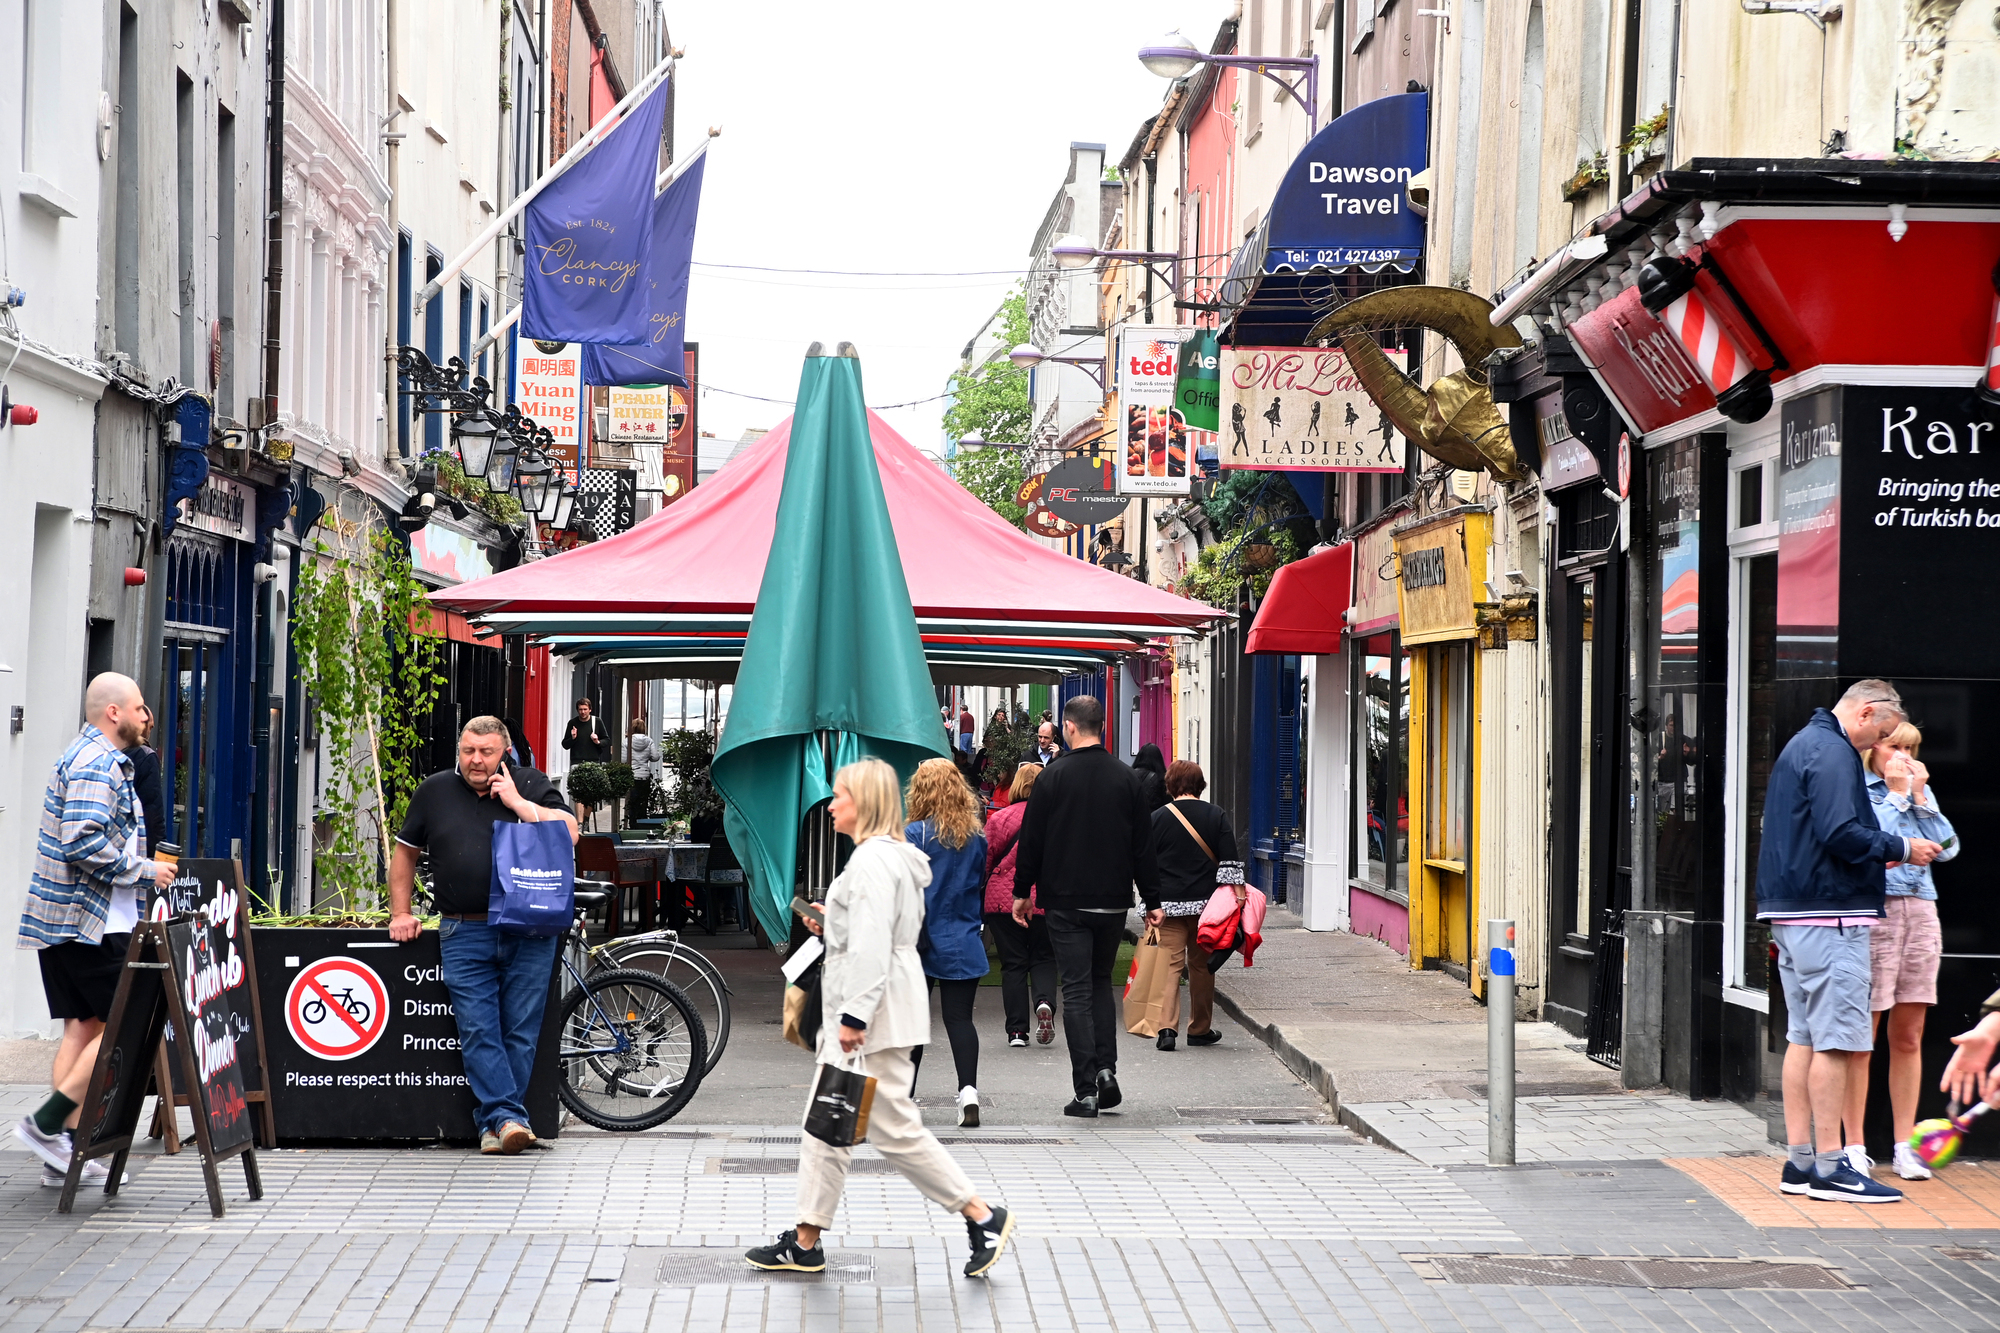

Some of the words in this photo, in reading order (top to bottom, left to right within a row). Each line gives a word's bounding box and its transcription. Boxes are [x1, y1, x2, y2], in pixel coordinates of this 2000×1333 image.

[1310, 161, 1411, 183] Dawson
[1321, 193, 1399, 215] Travel
[565, 219, 585, 230] Est.
[590, 218, 617, 234] 1824
[535, 237, 640, 293] Clancys
[1285, 250, 1309, 262] Tel:
[1317, 250, 1340, 262] 021
[1345, 250, 1400, 263] 4274397
[562, 274, 607, 287] CORK
[1188, 351, 1220, 370] Ae
[521, 382, 575, 398] Yuan
[612, 393, 667, 405] PEARL
[521, 402, 576, 422] Ming
[613, 407, 665, 419] RIVER
[1262, 440, 1364, 456] LADIES
[1785, 420, 1838, 470] Karizma
[1253, 457, 1372, 467] ACCESSORIES
[1020, 478, 1040, 501] CORK
[1658, 461, 1693, 505] Karizma
[1878, 477, 1964, 502] Bringing
[1968, 478, 2000, 497] the
[584, 495, 599, 508] 19
[1048, 487, 1079, 501] PC
[619, 478, 633, 534] NAS
[1875, 507, 1899, 526] of
[1900, 507, 1972, 527] Turkish
[1975, 508, 2000, 527] ba
[168, 888, 196, 915] Night
[185, 945, 222, 1017] Lunch
[404, 965, 444, 986] Cycli
[206, 1010, 223, 1027] AND
[194, 1018, 236, 1086] Dinner
[285, 1072, 333, 1087] Please
[337, 1073, 391, 1089] respect
[395, 1072, 422, 1087] this
